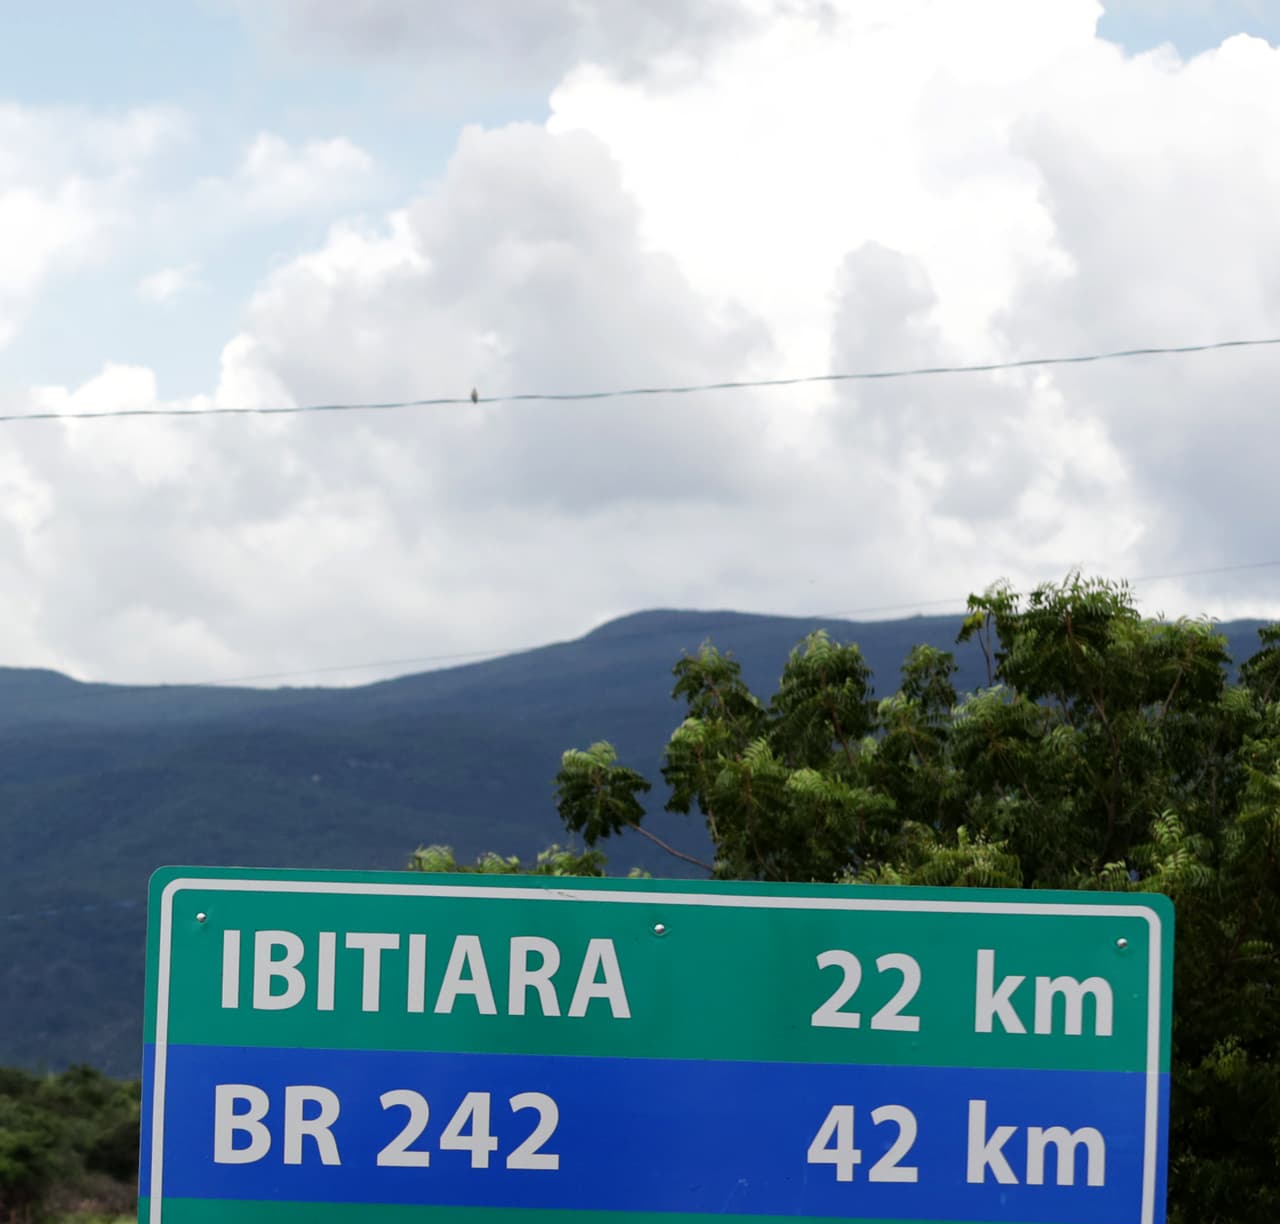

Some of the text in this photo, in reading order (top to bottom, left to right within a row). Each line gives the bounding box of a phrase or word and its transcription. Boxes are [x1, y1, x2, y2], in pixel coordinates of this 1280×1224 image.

[221, 930, 1113, 1036] IBITIARA 22 km
[214, 1084, 1105, 1186] BR 242 42 km
